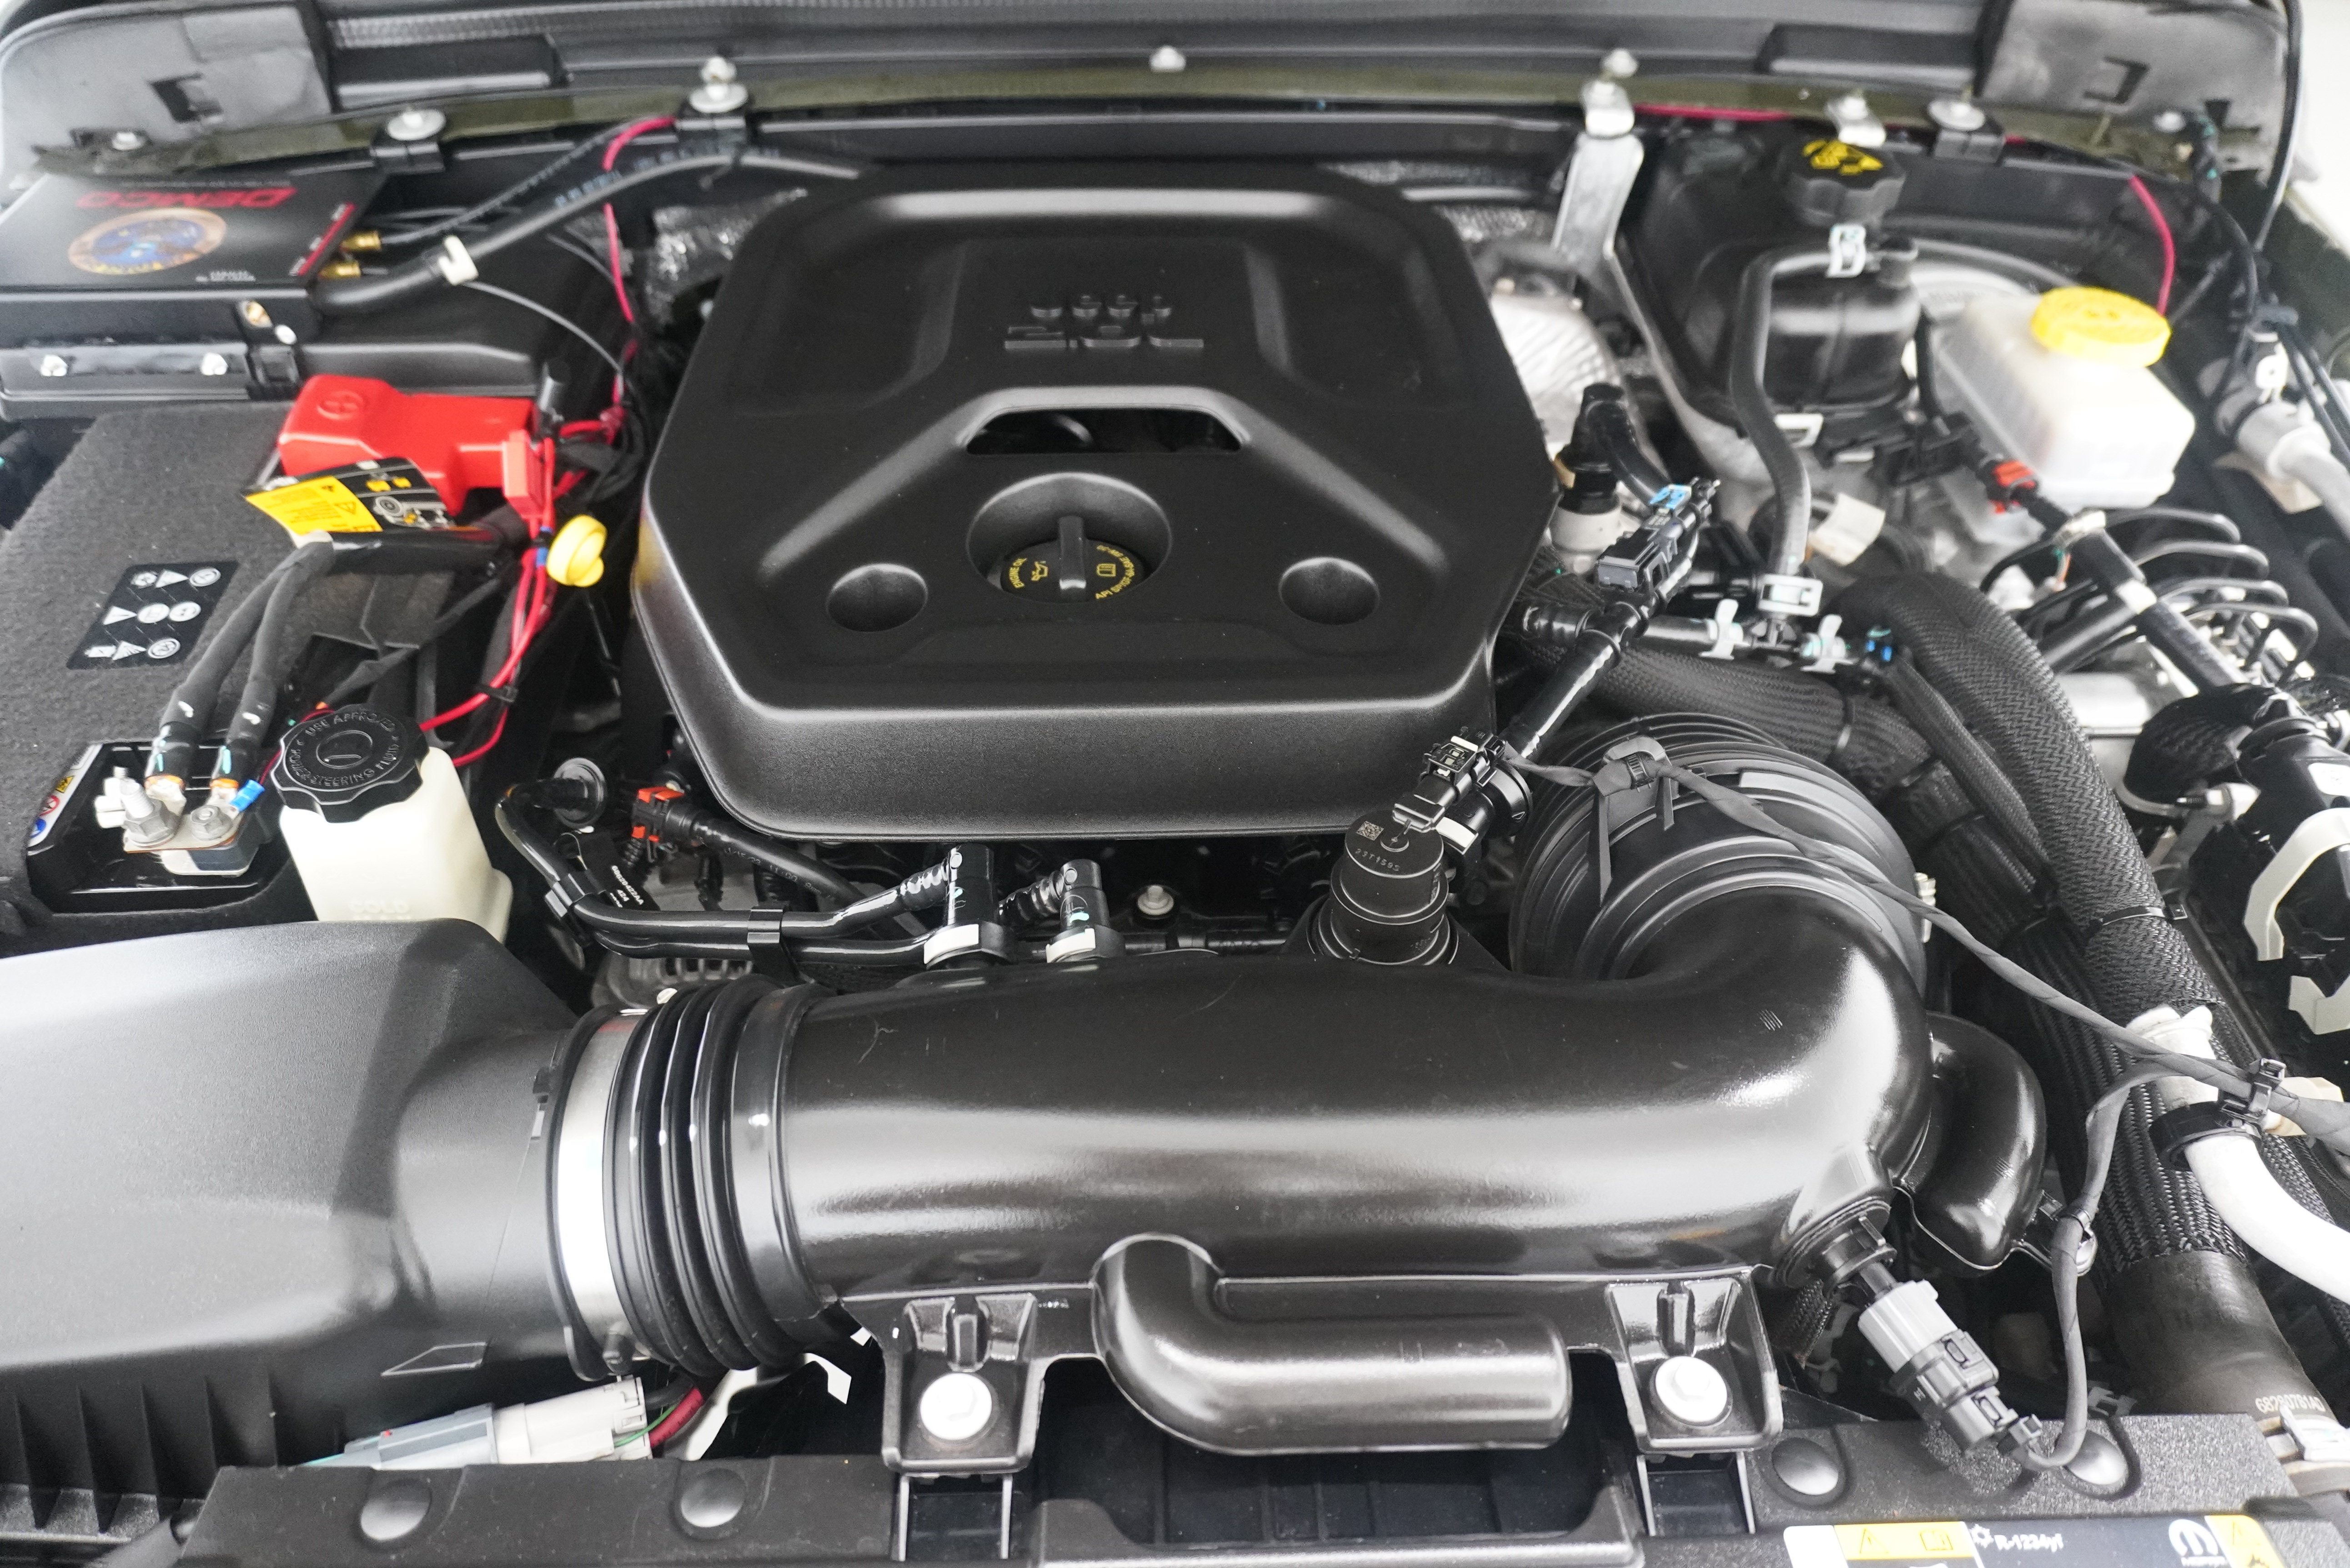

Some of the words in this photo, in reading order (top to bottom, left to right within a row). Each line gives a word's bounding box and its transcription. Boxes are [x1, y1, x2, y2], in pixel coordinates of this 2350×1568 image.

[1013, 557, 1028, 568] OIL
[1009, 567, 1025, 589] ENGINE
[1095, 590, 1113, 599] API
[305, 719, 331, 736] USE
[333, 712, 396, 732] APPROVED
[311, 768, 375, 786] STEERING
[617, 890, 629, 901] 424
